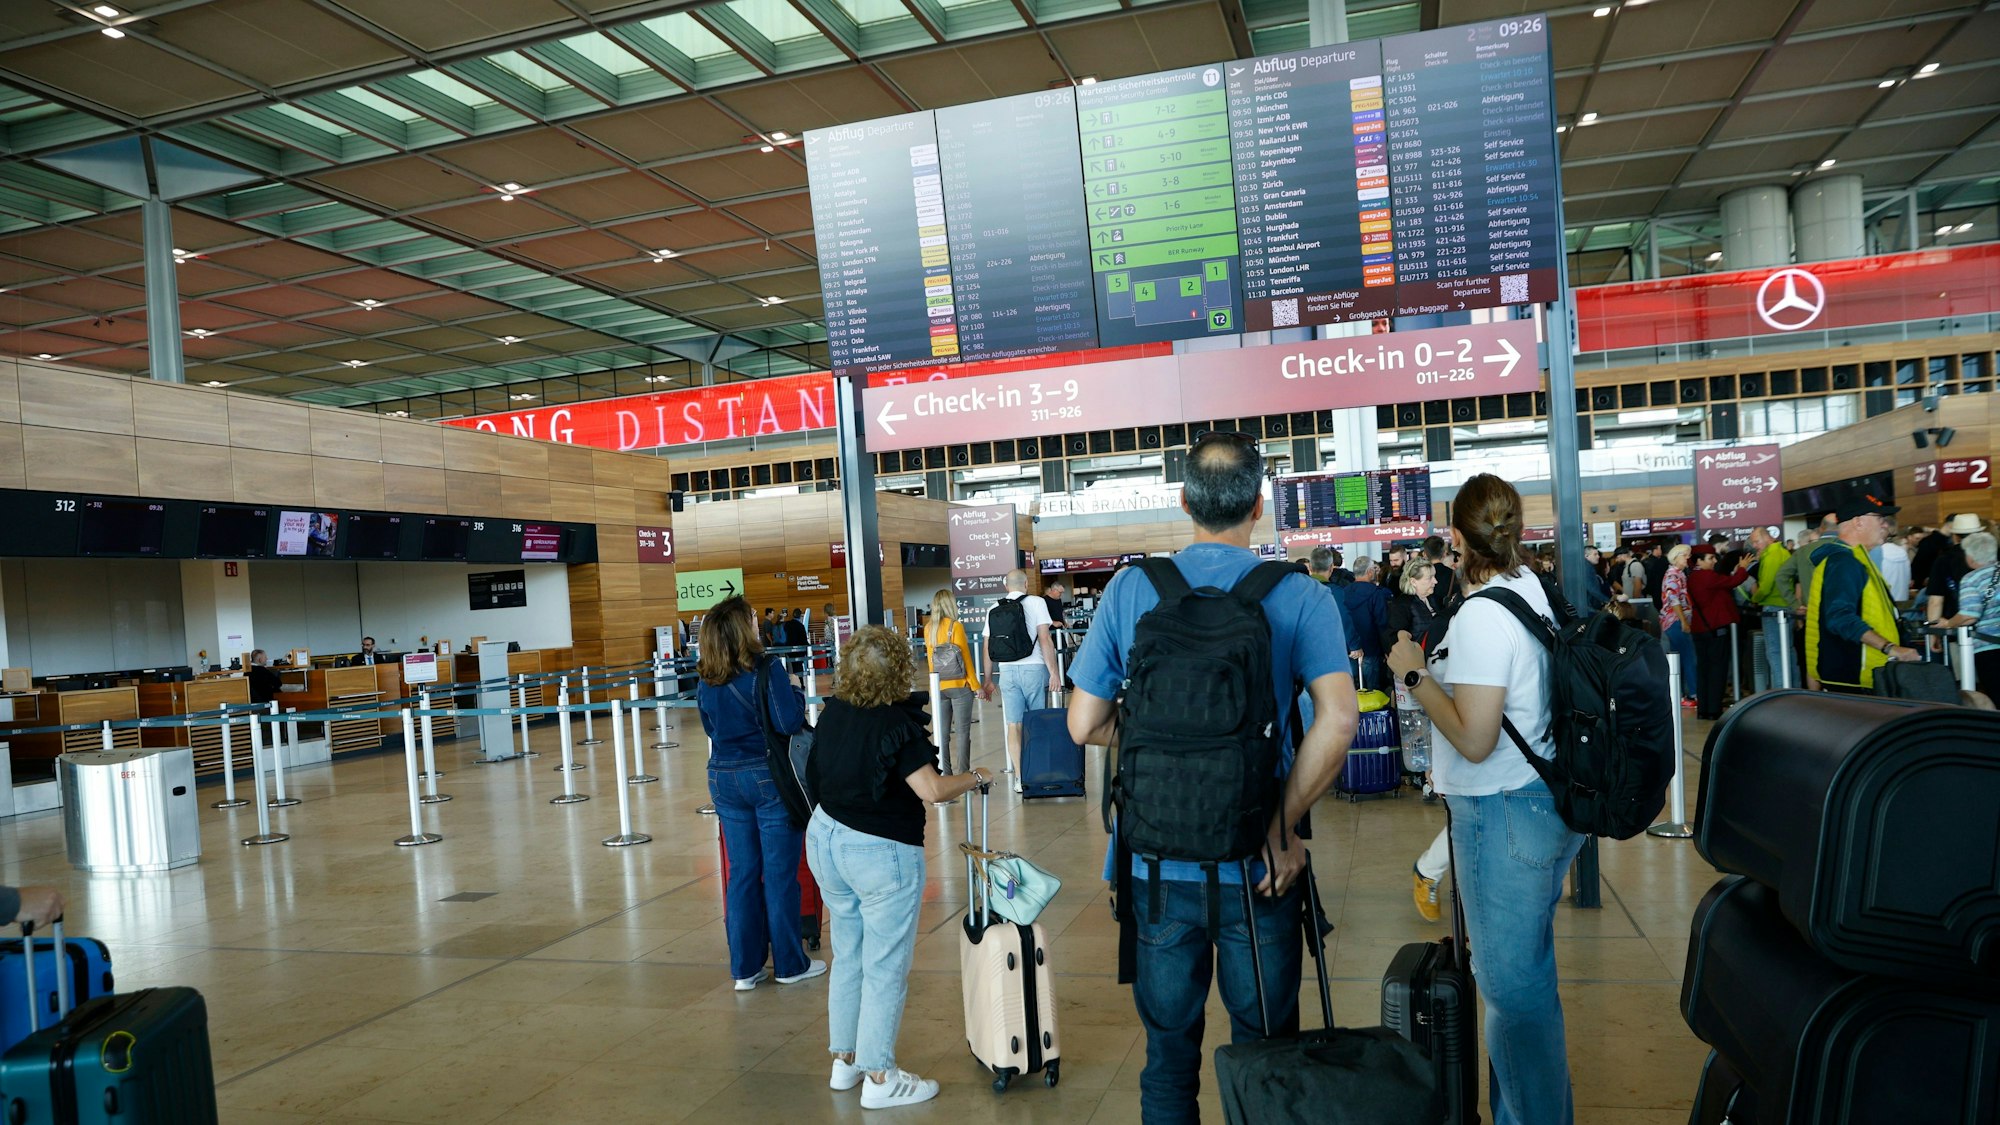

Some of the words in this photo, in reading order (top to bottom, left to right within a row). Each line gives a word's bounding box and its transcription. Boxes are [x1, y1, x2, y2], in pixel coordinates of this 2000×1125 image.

[1499, 17, 1541, 37] 09:26
[1475, 40, 1509, 53] Bemerkung
[1252, 54, 1296, 77] Abflug
[1300, 48, 1355, 70] Departure
[1205, 72, 1216, 82] T1
[1079, 84, 1116, 97] Wartezeit
[1118, 70, 1196, 91] Sicherheitskontrolle
[1034, 90, 1070, 108] 09:26
[1080, 96, 1103, 106] Waiting
[1103, 93, 1118, 102] Time
[1120, 89, 1144, 100] Security
[1145, 85, 1168, 95] Control
[1255, 92, 1272, 102] Paris
[1273, 90, 1287, 99] CDG
[1256, 101, 1288, 113] München
[1427, 100, 1458, 111] 021-026
[1115, 113, 1119, 122] 1
[1155, 103, 1176, 115] 7-12
[1257, 114, 1274, 124] Izmir
[1275, 112, 1290, 121] ADB
[826, 124, 864, 146] Abflug
[867, 119, 914, 138] Departure
[1258, 126, 1273, 134] New
[1274, 123, 1290, 132] York
[1291, 121, 1307, 130] EWR
[1117, 136, 1123, 145] 2
[1157, 127, 1176, 139] 4-9
[1258, 134, 1286, 145] Mailand
[1287, 133, 1299, 141] LIN
[1259, 144, 1302, 158] Kopenhagen
[1430, 145, 1460, 156] 323-326
[1119, 160, 1125, 169] 4
[1159, 151, 1182, 163] 5-10
[1260, 156, 1296, 169] Zakynthos
[1261, 169, 1277, 180] Split
[1121, 183, 1128, 193] 5
[1161, 175, 1180, 186] 3-8
[1262, 179, 1283, 189] Zürich
[1263, 191, 1279, 199] Gran
[1280, 187, 1305, 197] Canaria
[1432, 190, 1463, 201] 924-926
[1163, 199, 1180, 210] 1-6
[1263, 198, 1303, 210] Amsterdam
[1264, 211, 1287, 221] Dublin
[983, 227, 1009, 238] 011-016
[1165, 223, 1188, 233] Priority
[1189, 221, 1203, 229] Lane
[1265, 221, 1299, 233] Hurghada
[1266, 231, 1298, 242] Frankfurt
[840, 249, 854, 257] New
[854, 246, 868, 254] York
[868, 245, 879, 253] JFK
[1167, 248, 1181, 256] BER
[1181, 244, 1205, 255] Runway
[1267, 243, 1295, 253] Istanbul
[1296, 240, 1320, 251] Airport
[841, 257, 863, 266] London
[986, 257, 1012, 267] 224-226
[1029, 250, 1065, 263] Abfertigung
[842, 267, 863, 276] Madrid
[1213, 266, 1218, 275] 1
[1269, 265, 1294, 274] London
[1295, 263, 1309, 271] LHR
[844, 277, 866, 287] Belgrad
[1115, 277, 1121, 287] 5
[1186, 280, 1193, 291] 2
[1269, 274, 1300, 285] Teneriffa
[1366, 276, 1391, 285] easyJet
[1436, 280, 1452, 289] Scan
[1453, 278, 1464, 287] for
[1465, 276, 1490, 286] further
[845, 286, 867, 297] Antalya
[1141, 286, 1147, 296] 4
[1248, 290, 1266, 298] 11:10
[1270, 285, 1303, 295] Barcelona
[1306, 293, 1332, 302] Weitere
[1332, 290, 1359, 301] Abflüge
[1453, 286, 1490, 298] Departures
[847, 306, 867, 315] Vilnius
[1307, 302, 1328, 312] finden
[1329, 301, 1339, 309] Sie
[1340, 300, 1354, 308] hier
[1399, 306, 1418, 316] Bulky
[1419, 303, 1448, 314] Baggage
[848, 316, 866, 325] Zürich
[1215, 316, 1225, 324] T2
[1348, 308, 1388, 322] Großgepäck
[849, 326, 865, 334] Doha
[850, 336, 864, 344] Oslo
[853, 354, 877, 363] Istanbul
[963, 352, 990, 361] sämtliche
[991, 348, 1026, 359] Abfluggates
[1026, 344, 1058, 354] erreichbar.
[877, 363, 892, 371] jeder
[892, 356, 948, 369] Sicherheitskontrolle
[1281, 346, 1404, 379] Check-in
[1414, 339, 1473, 367] 0–2
[1416, 369, 1475, 385] 011–226
[914, 385, 1021, 417] Check-in
[1029, 379, 1079, 405] 3–9
[616, 386, 826, 451] DISTAN
[1031, 406, 1082, 422] 311–926
[1715, 452, 1746, 462] Abflug
[1715, 460, 1750, 469] Departure
[1969, 460, 1989, 483] 2
[1722, 476, 1762, 487] Check-in
[55, 500, 75, 511] 312
[1718, 501, 1757, 511] Check-in
[963, 511, 986, 519] Abflug
[473, 522, 484, 531] 315
[511, 524, 522, 532] 316
[969, 533, 999, 541] Check-in
[638, 530, 656, 538] Check-in
[662, 531, 672, 557] 3
[965, 553, 996, 561] Check-in
[676, 583, 714, 600] ates
[121, 771, 136, 779] BER
